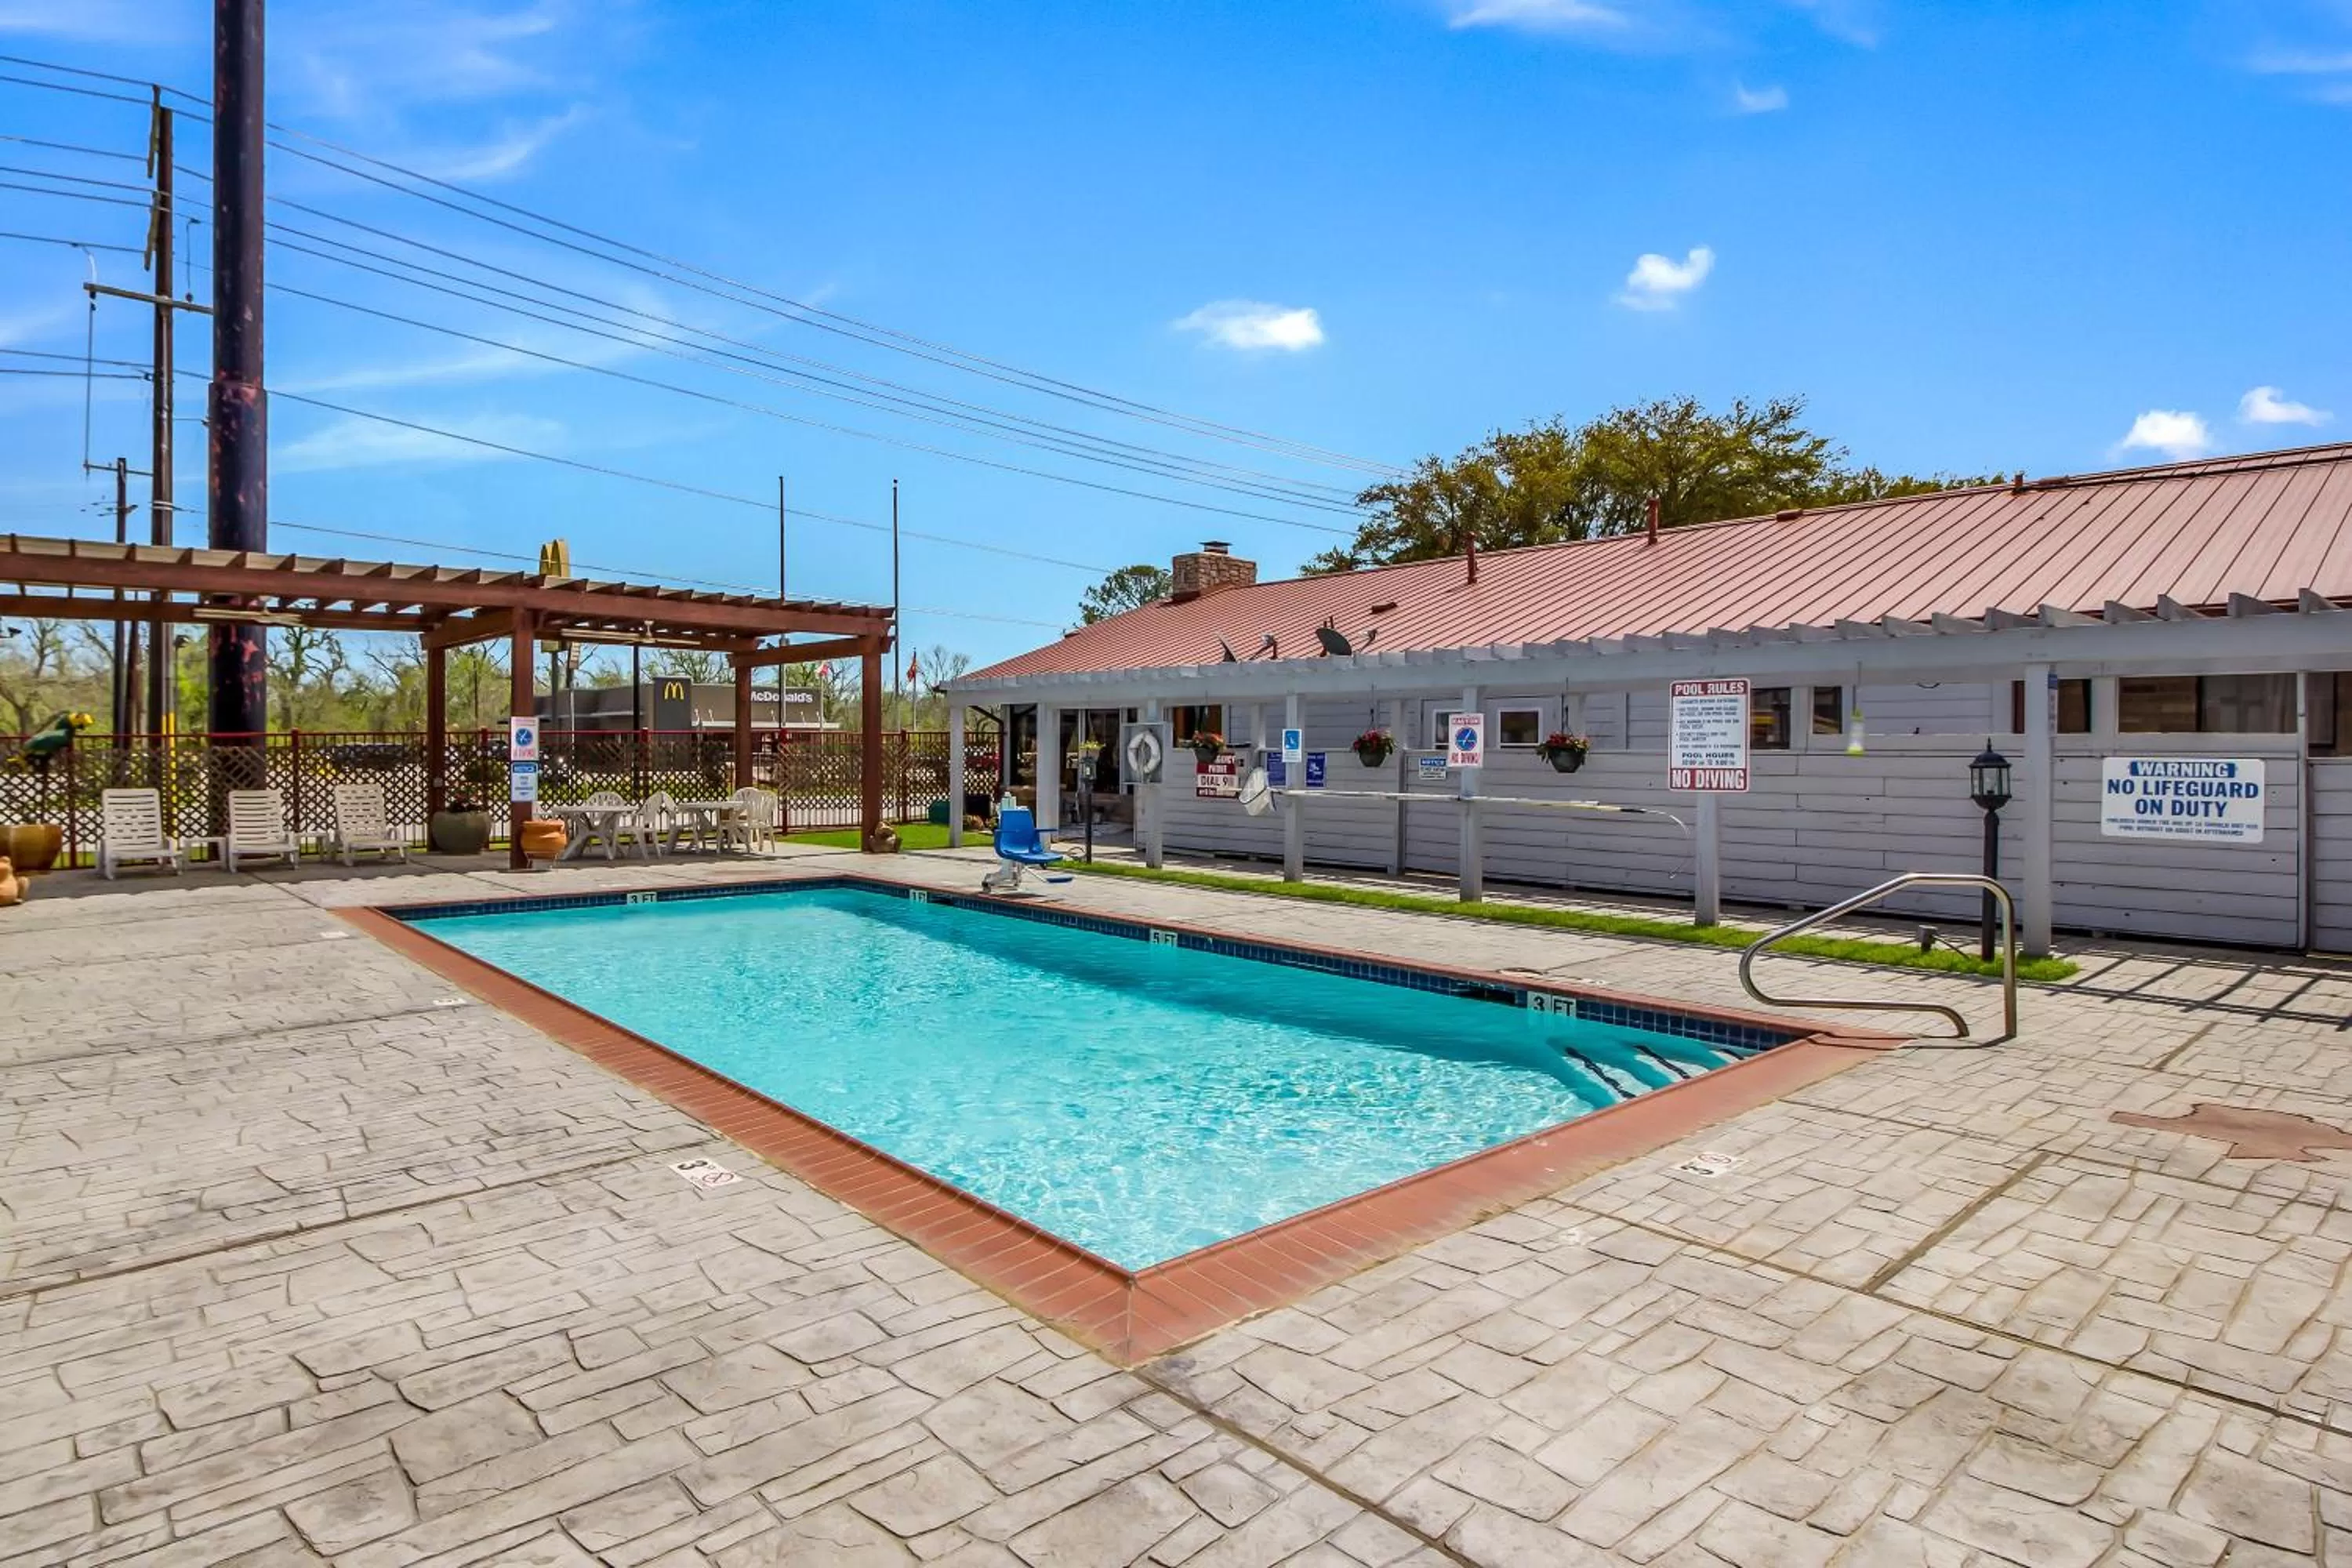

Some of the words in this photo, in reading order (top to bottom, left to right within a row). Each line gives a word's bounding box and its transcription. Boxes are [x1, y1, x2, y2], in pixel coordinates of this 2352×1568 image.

[1675, 684, 1704, 695] POOL
[1708, 681, 1744, 694] RULES
[750, 691, 813, 703] McDoald's
[2137, 762, 2229, 777] WARNING
[1671, 769, 1691, 788] NO
[1696, 769, 1744, 789] DIVING
[2107, 779, 2134, 794] NO
[2143, 780, 2259, 799] LIFEGUARD
[2135, 799, 2162, 815] ON
[2171, 800, 2227, 817] DUTY
[1164, 934, 1176, 947] FT
[1533, 996, 1544, 1011] 3
[1553, 998, 1574, 1017] FT
